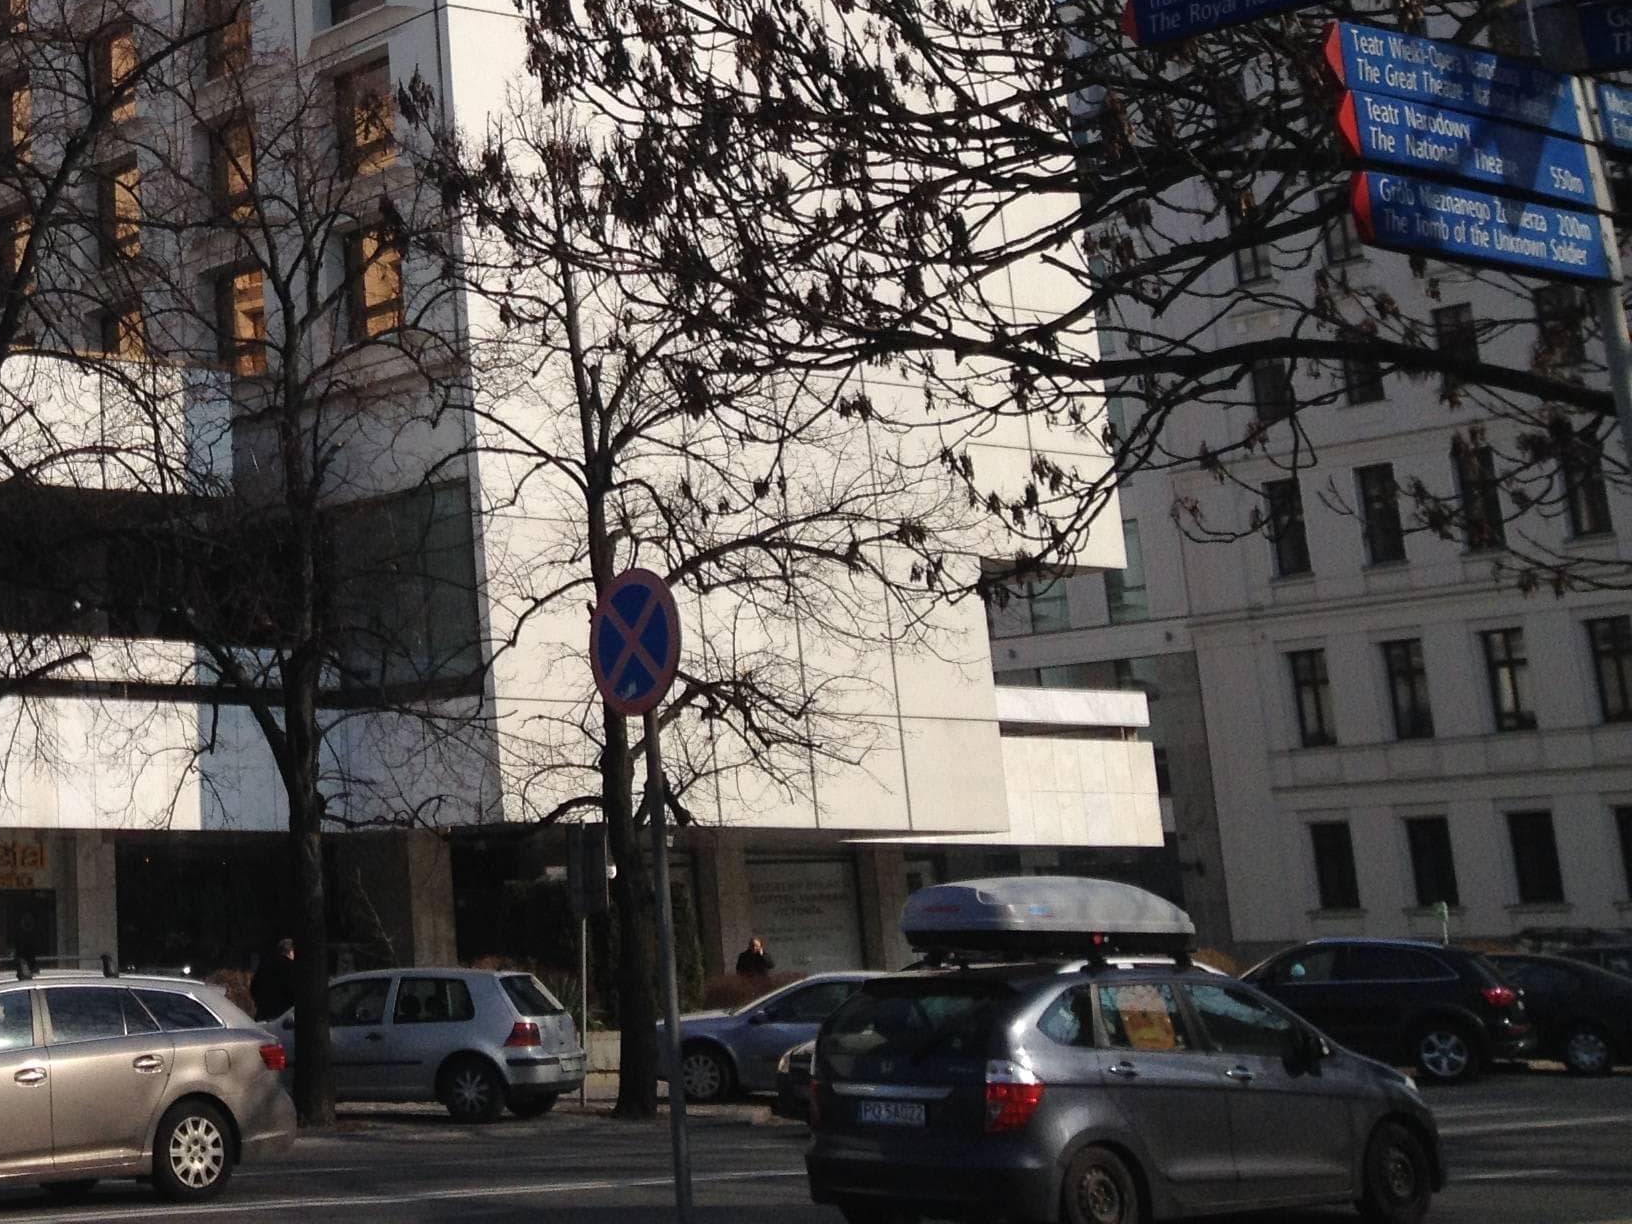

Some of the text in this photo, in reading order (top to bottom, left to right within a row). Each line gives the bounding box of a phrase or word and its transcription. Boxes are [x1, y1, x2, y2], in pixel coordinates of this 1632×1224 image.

[1149, 11, 1181, 33] The
[1350, 29, 1385, 57] Teatr
[1356, 57, 1380, 84] The
[1384, 63, 1418, 91] Great
[1364, 96, 1472, 144] Teatr Narodowy
[1368, 126, 1395, 153] The
[1384, 208, 1408, 234] The
[1414, 212, 1449, 241] Tomb
[1454, 219, 1467, 243] of
[1470, 224, 1489, 248] the
[1494, 228, 1547, 258] Unknown
[1556, 213, 1592, 241] 200m
